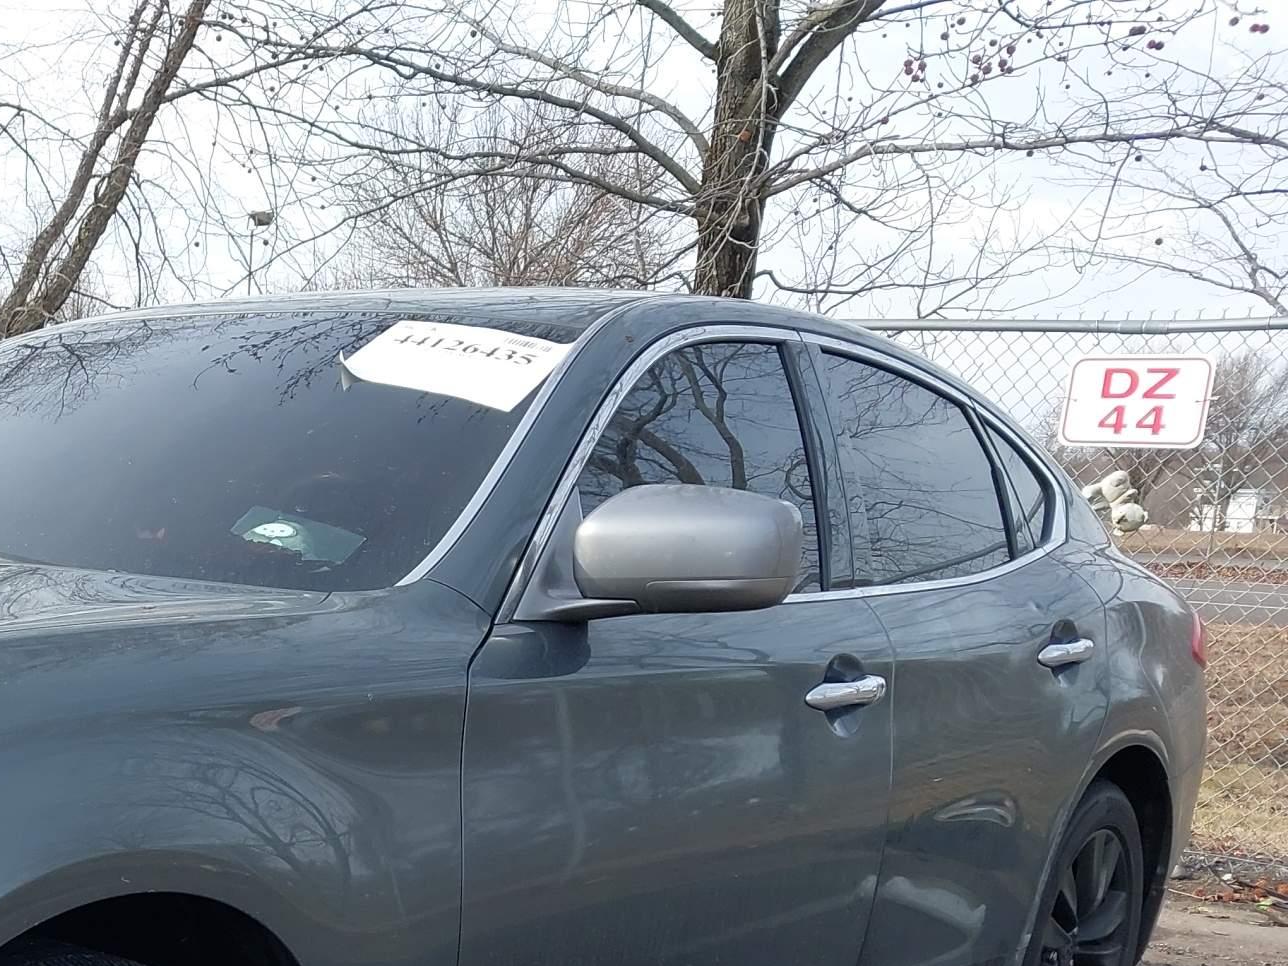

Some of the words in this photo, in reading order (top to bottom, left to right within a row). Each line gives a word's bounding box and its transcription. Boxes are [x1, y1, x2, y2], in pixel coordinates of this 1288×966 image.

[393, 334, 537, 366] 44126435
[1100, 367, 1179, 400] DZ
[1097, 404, 1166, 435] 44
